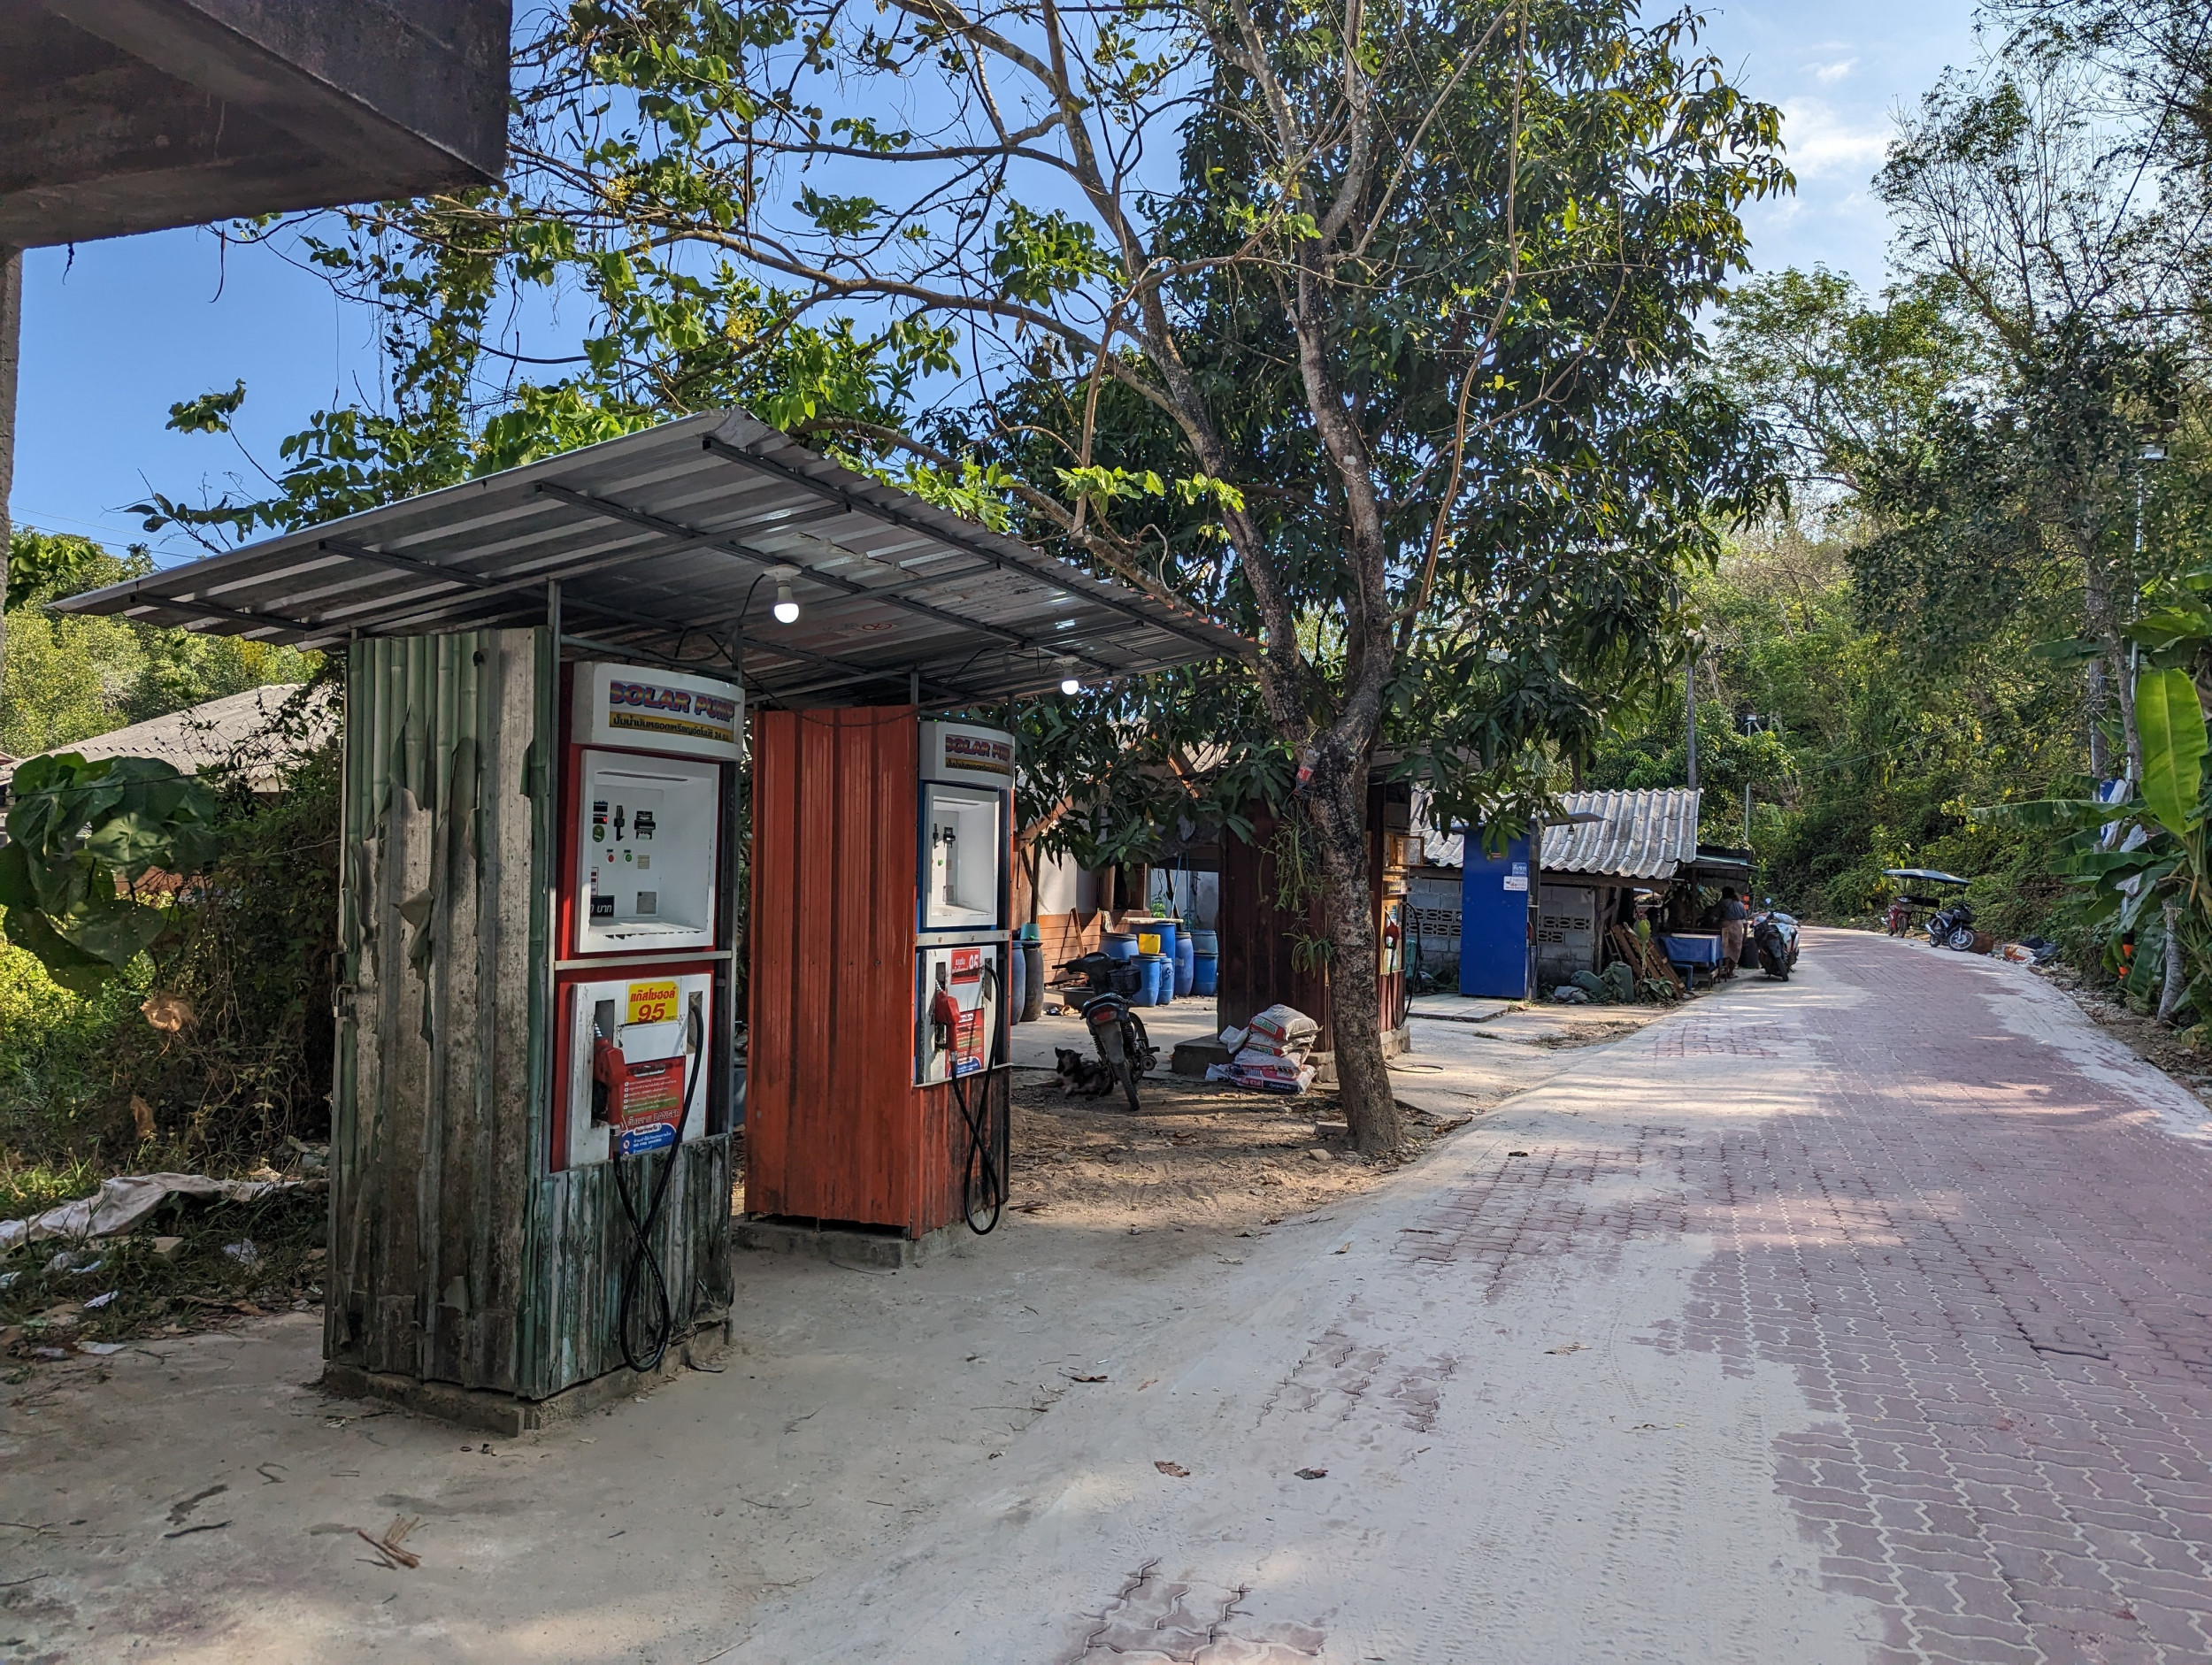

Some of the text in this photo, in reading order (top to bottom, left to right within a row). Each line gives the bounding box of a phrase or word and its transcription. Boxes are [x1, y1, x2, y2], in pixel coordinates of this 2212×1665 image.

[611, 682, 734, 722] SOLAR PUMP
[715, 732, 721, 740] 24
[946, 736, 990, 757] SOLAR
[596, 904, 612, 913] บาท
[637, 1002, 666, 1023] 95
[653, 1109, 680, 1122] DANGER
